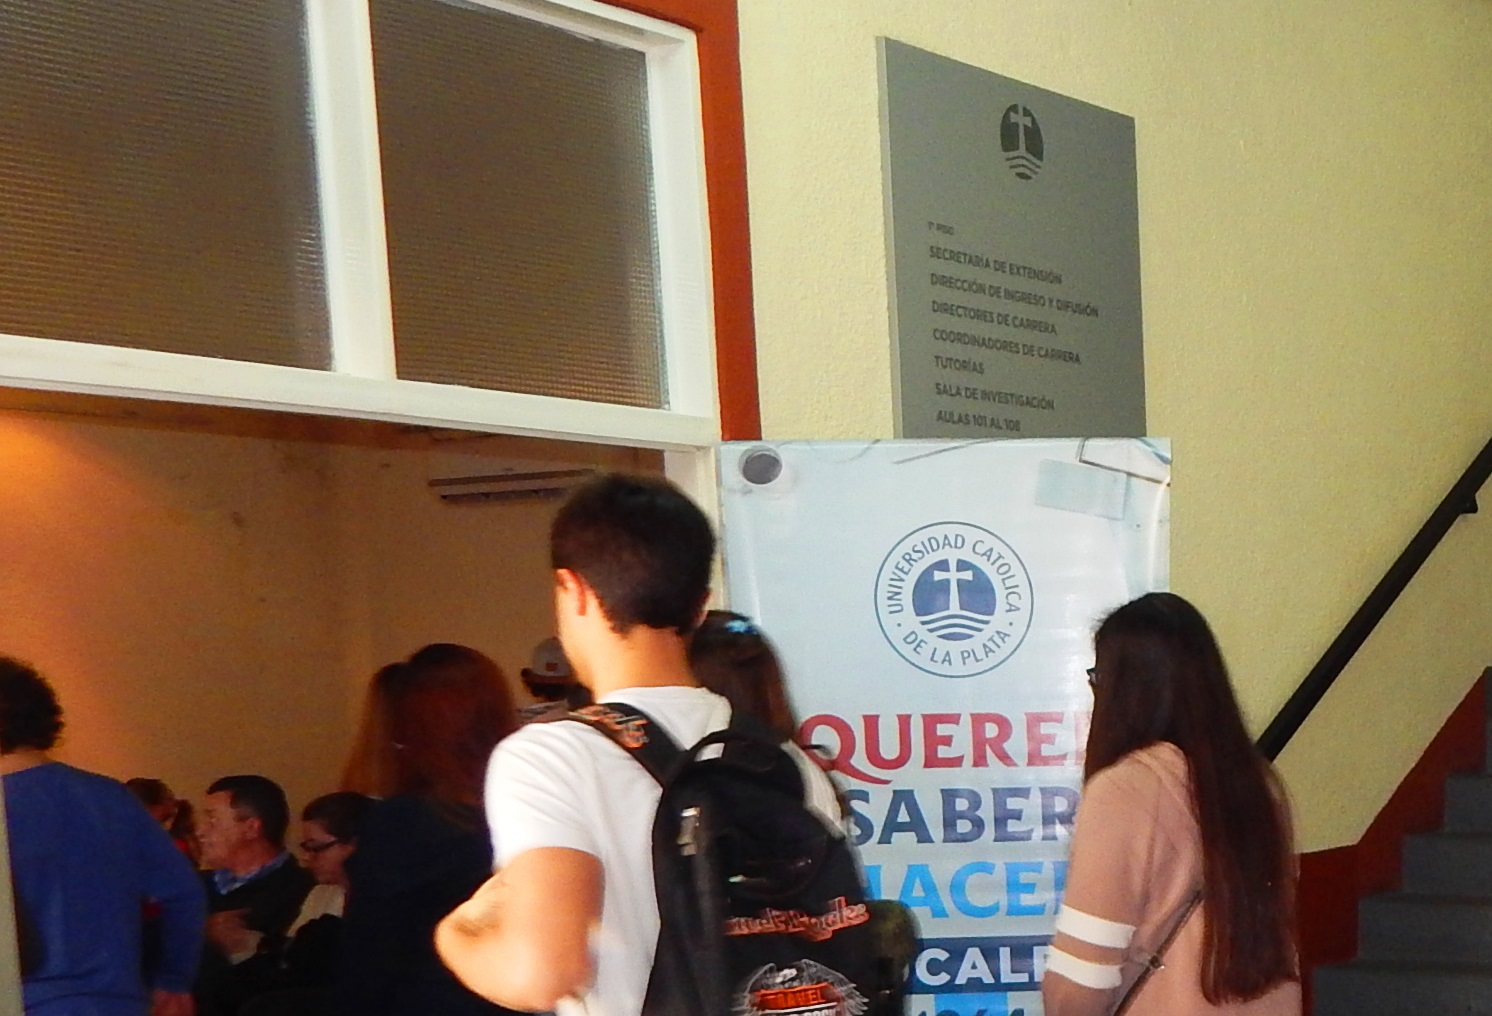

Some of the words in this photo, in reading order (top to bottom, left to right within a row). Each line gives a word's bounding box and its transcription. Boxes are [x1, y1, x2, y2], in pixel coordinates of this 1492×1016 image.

[929, 245, 991, 269] SECRETARÍA
[993, 260, 1007, 274] DE
[1009, 263, 1063, 285] EXTENSIÓN
[930, 273, 987, 296] DIRECCIÓN
[989, 285, 1002, 299] DE
[1003, 288, 1046, 308] INGRESO
[1048, 298, 1055, 310] Y
[1056, 299, 1099, 319] DIFUSIÓN
[931, 300, 995, 324] DIRECTORES
[997, 313, 1010, 327] DE
[1011, 316, 1058, 337] CARRERA
[932, 328, 1021, 355] COORDINADORES
[1022, 344, 1035, 358] DE
[1037, 347, 1082, 365] CARRERA
[934, 356, 985, 375] TUTORÍAS
[935, 383, 962, 398] SALA
[964, 387, 979, 401] DE
[980, 390, 1055, 411] INVESTIGACIÓN
[935, 410, 971, 426] AULAS
[972, 415, 988, 428] 101
[989, 417, 1003, 431] AL
[886, 533, 966, 615] UNIVERSIDAD
[971, 539, 1022, 614] CATOLICA
[902, 630, 928, 655] DE
[929, 647, 952, 666] LA
[960, 629, 1012, 666] PLATA
[846, 786, 1081, 846] SABER
